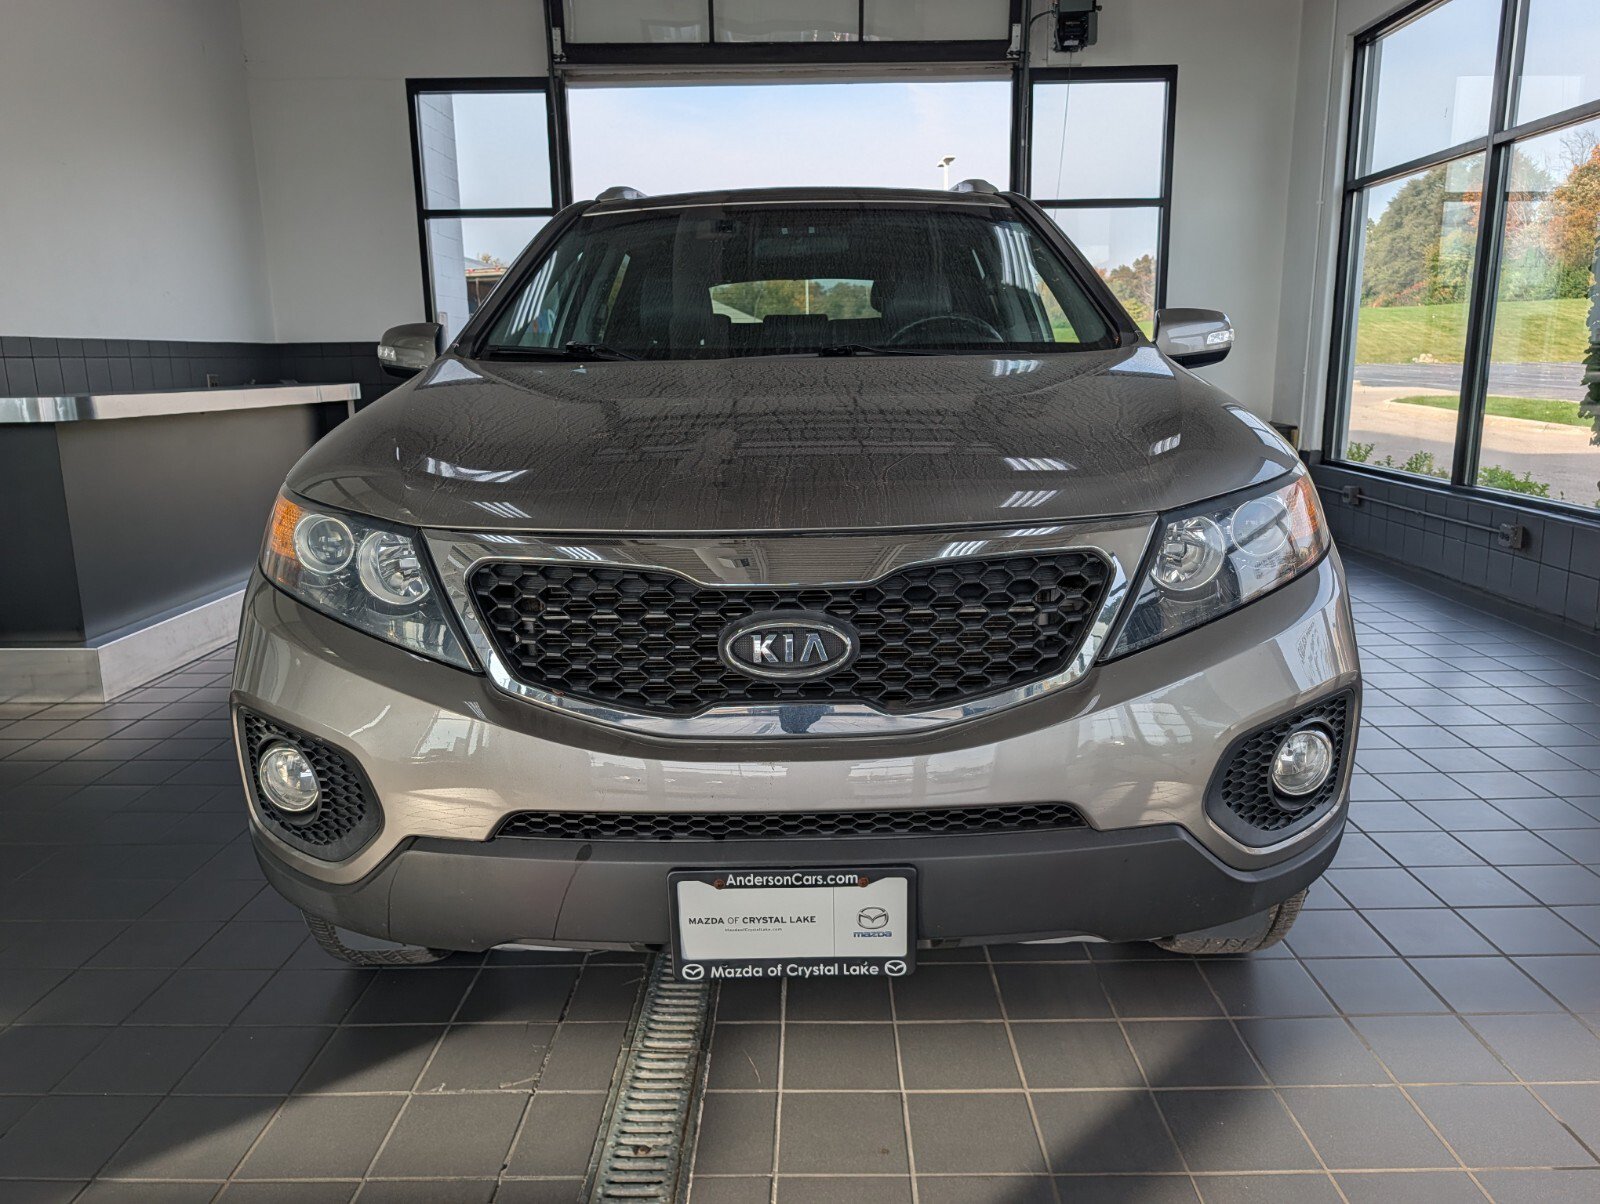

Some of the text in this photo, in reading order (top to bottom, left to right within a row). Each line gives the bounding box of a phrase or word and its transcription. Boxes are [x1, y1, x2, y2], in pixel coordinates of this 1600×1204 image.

[751, 633, 828, 662] KIA
[726, 873, 858, 886] AndersonCars.com
[688, 917, 725, 925] MAZDA
[742, 916, 787, 924] CRYSTAL
[789, 915, 817, 924] LAKE
[710, 961, 879, 978] Mazda of Crystal Lake
